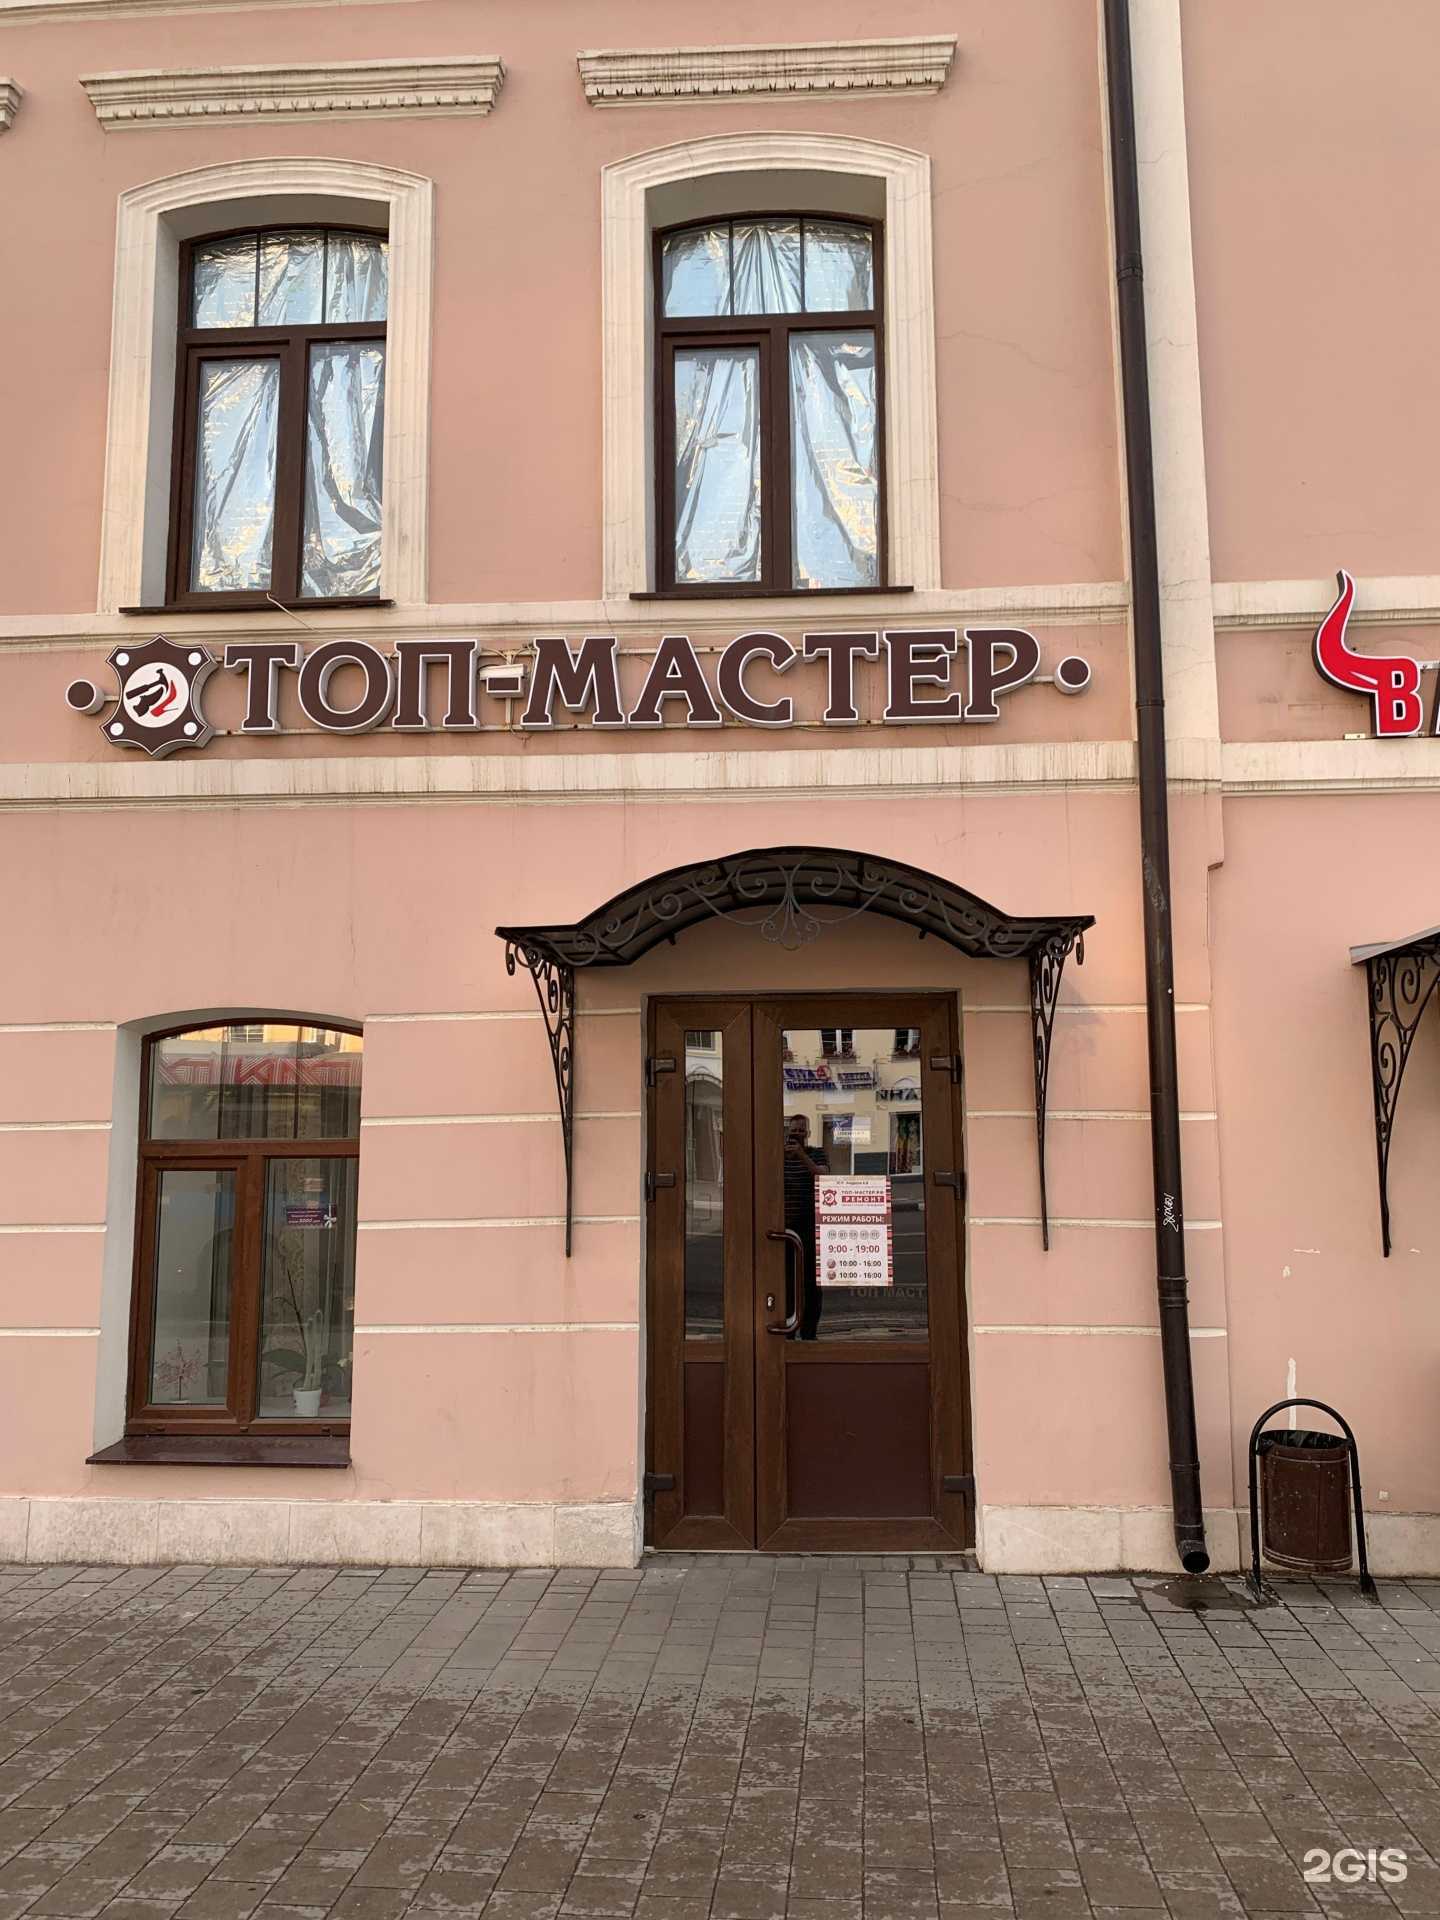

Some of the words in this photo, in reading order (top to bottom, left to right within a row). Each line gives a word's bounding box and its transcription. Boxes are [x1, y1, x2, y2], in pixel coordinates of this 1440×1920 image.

[224, 628, 1040, 732] ТОП-МАСТЕР
[822, 1215, 850, 1223] РЕЖИМ
[828, 1244, 847, 1253] 9:00
[856, 1244, 880, 1253] 19:00
